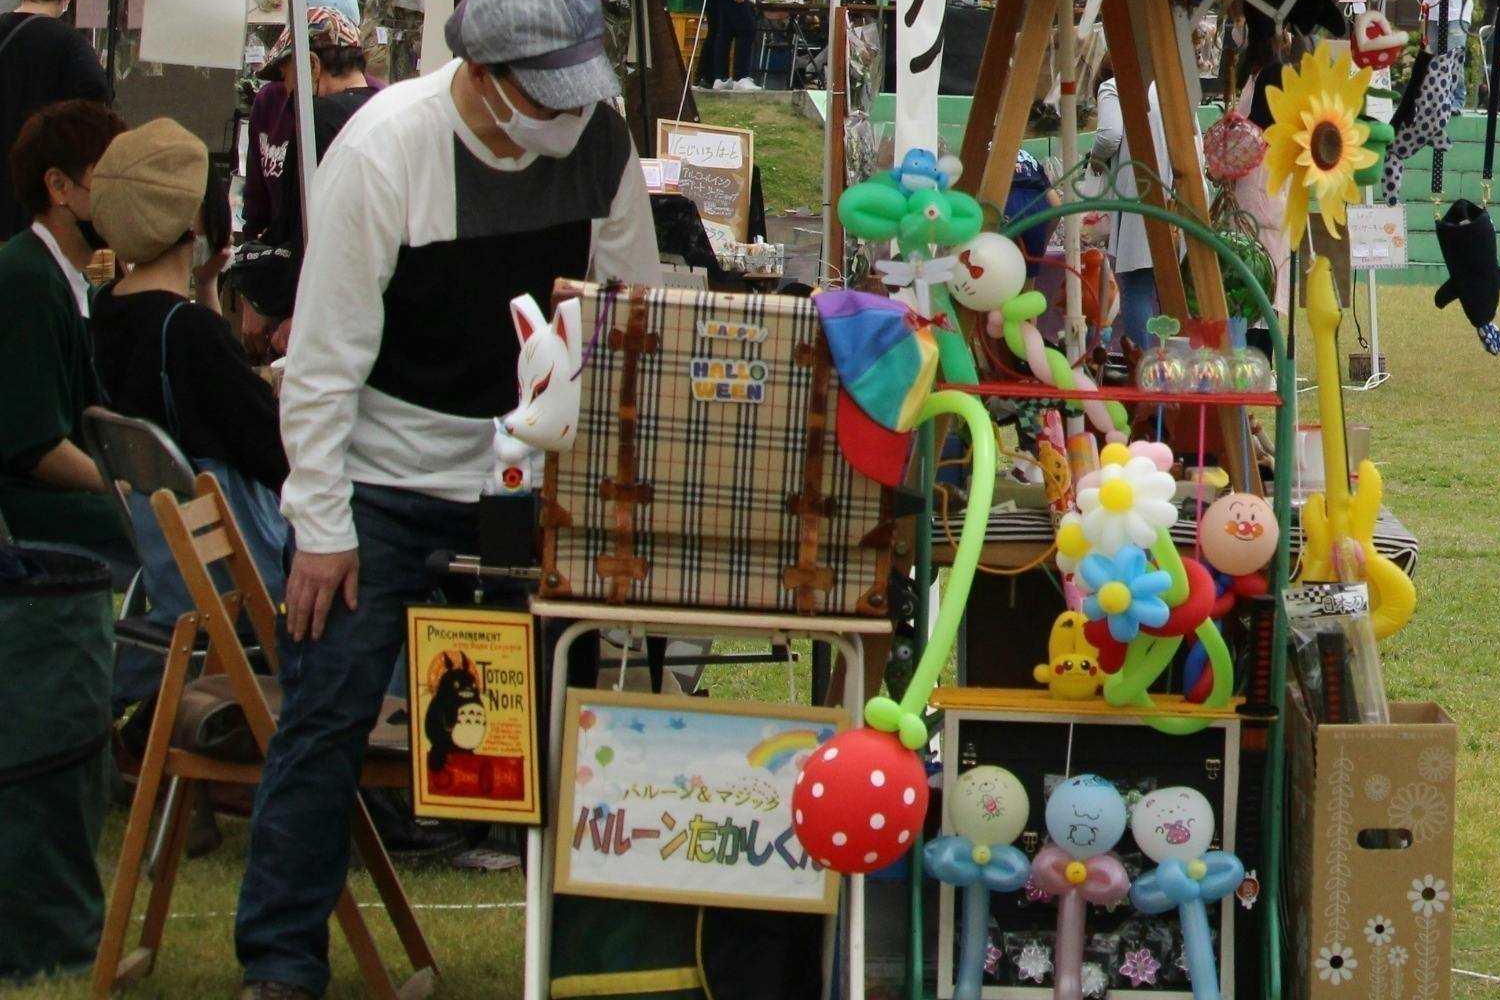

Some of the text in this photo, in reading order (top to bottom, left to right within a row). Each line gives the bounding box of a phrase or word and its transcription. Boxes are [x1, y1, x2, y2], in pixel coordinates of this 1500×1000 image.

[694, 381, 762, 401] WEEN
[475, 660, 525, 694] TOTORO
[487, 690, 525, 713] NOIR
